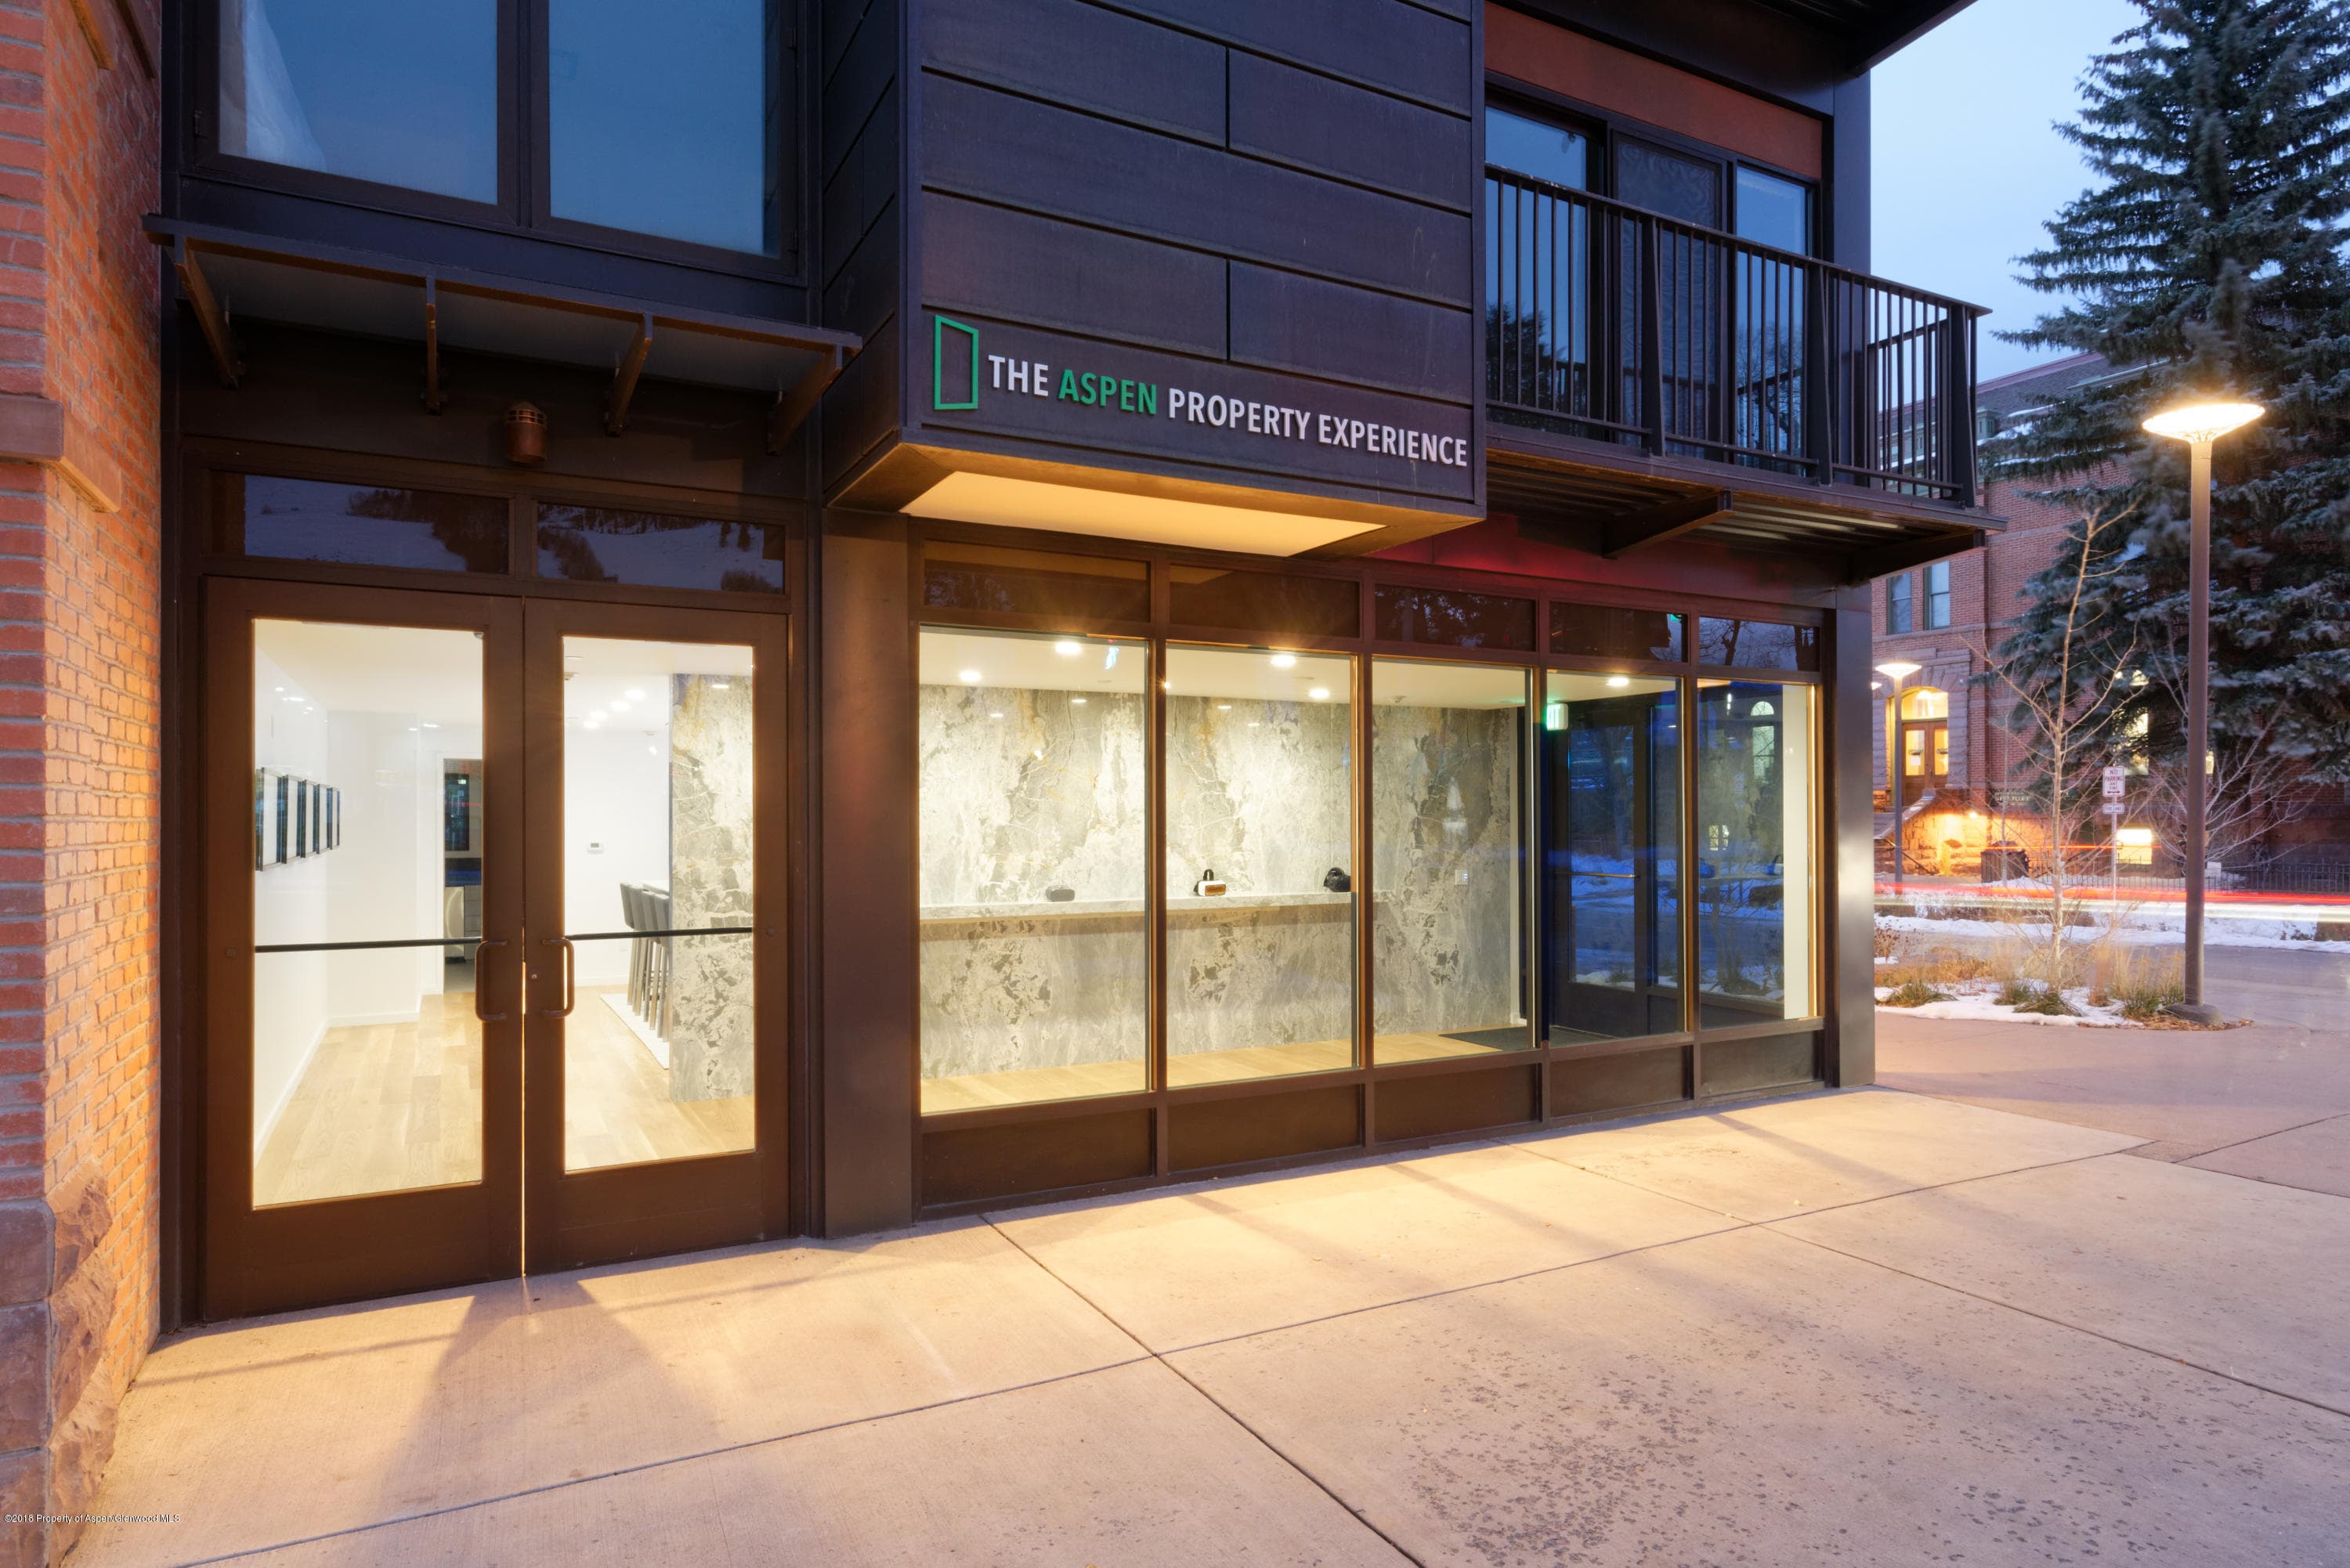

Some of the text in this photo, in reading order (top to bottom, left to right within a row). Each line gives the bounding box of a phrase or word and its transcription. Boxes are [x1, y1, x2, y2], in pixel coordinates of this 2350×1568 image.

[988, 354, 1468, 467] THE ASPEN PROPERTY EXPERIENCE
